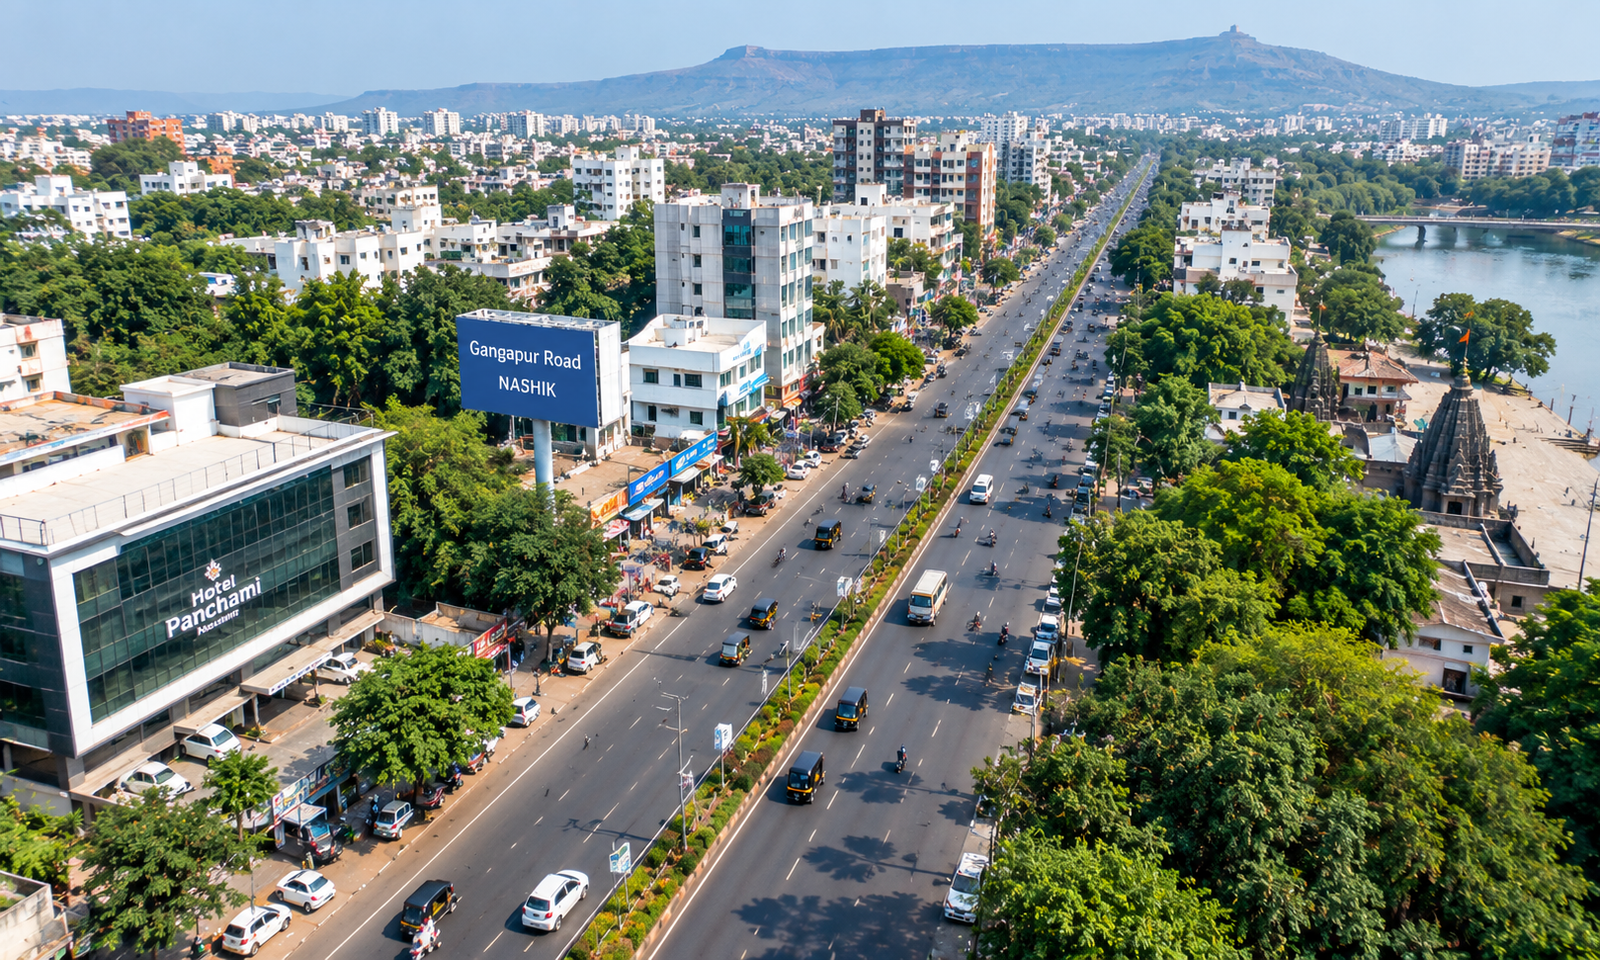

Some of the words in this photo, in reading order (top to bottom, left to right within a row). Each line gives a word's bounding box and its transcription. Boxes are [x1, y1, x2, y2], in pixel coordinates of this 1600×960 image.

[469, 340, 540, 365] Gangapur
[544, 349, 581, 370] Road
[499, 375, 557, 398] NASHIK
[191, 574, 236, 607] Hotel
[165, 576, 262, 638] Panchami
